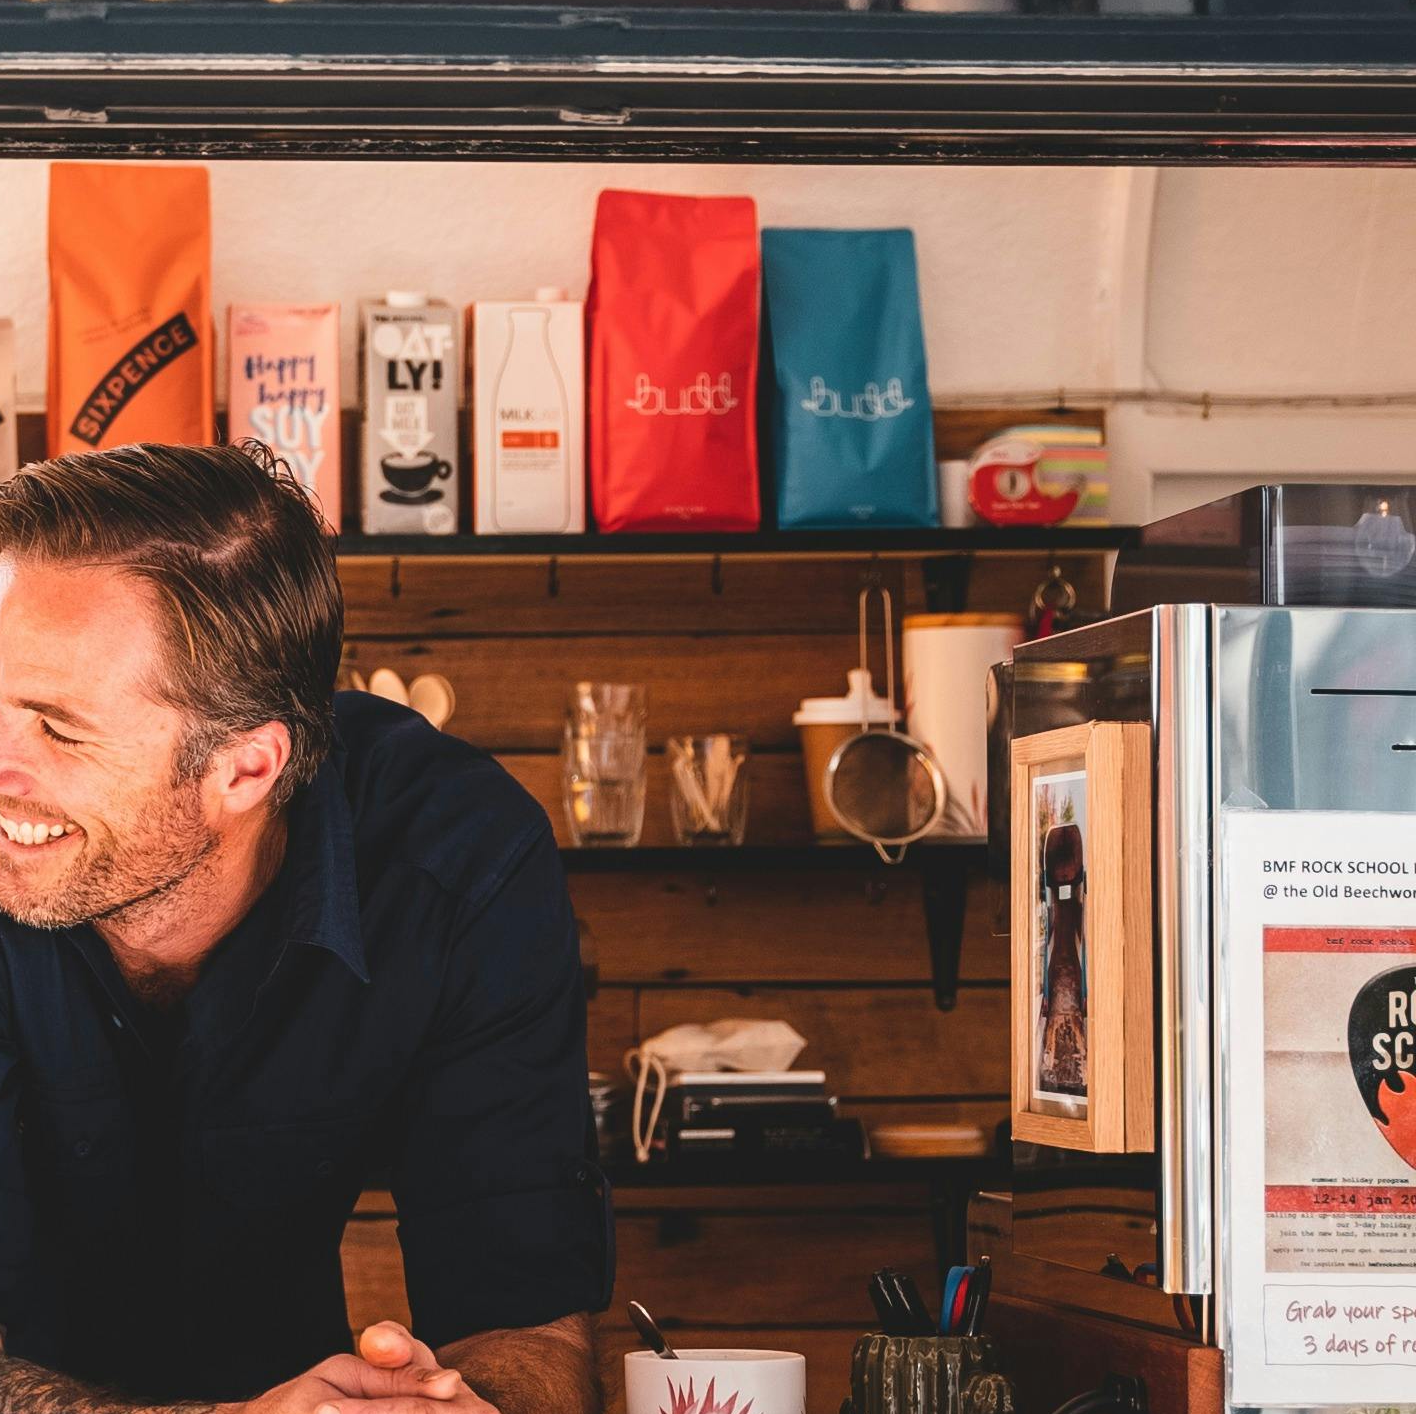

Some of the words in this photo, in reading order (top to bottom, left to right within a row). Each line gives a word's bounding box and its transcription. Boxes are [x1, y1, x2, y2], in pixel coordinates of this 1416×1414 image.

[77, 324, 189, 438] SIXPENCE
[388, 359, 442, 391] LY!
[1263, 860, 1296, 873] BMF
[1301, 861, 1343, 873] ROCK
[1347, 861, 1409, 874] SCHOOL
[1263, 884, 1278, 899] @
[1283, 885, 1308, 898] the
[1313, 885, 1338, 898] Old
[1313, 1193, 1356, 1205] 12-14
[1366, 1194, 1392, 1208] jan
[1286, 1299, 1337, 1323] Grab
[1344, 1305, 1385, 1323] your
[1304, 1335, 1318, 1356] 3
[1325, 1333, 1370, 1357] days
[1375, 1333, 1397, 1355] of
